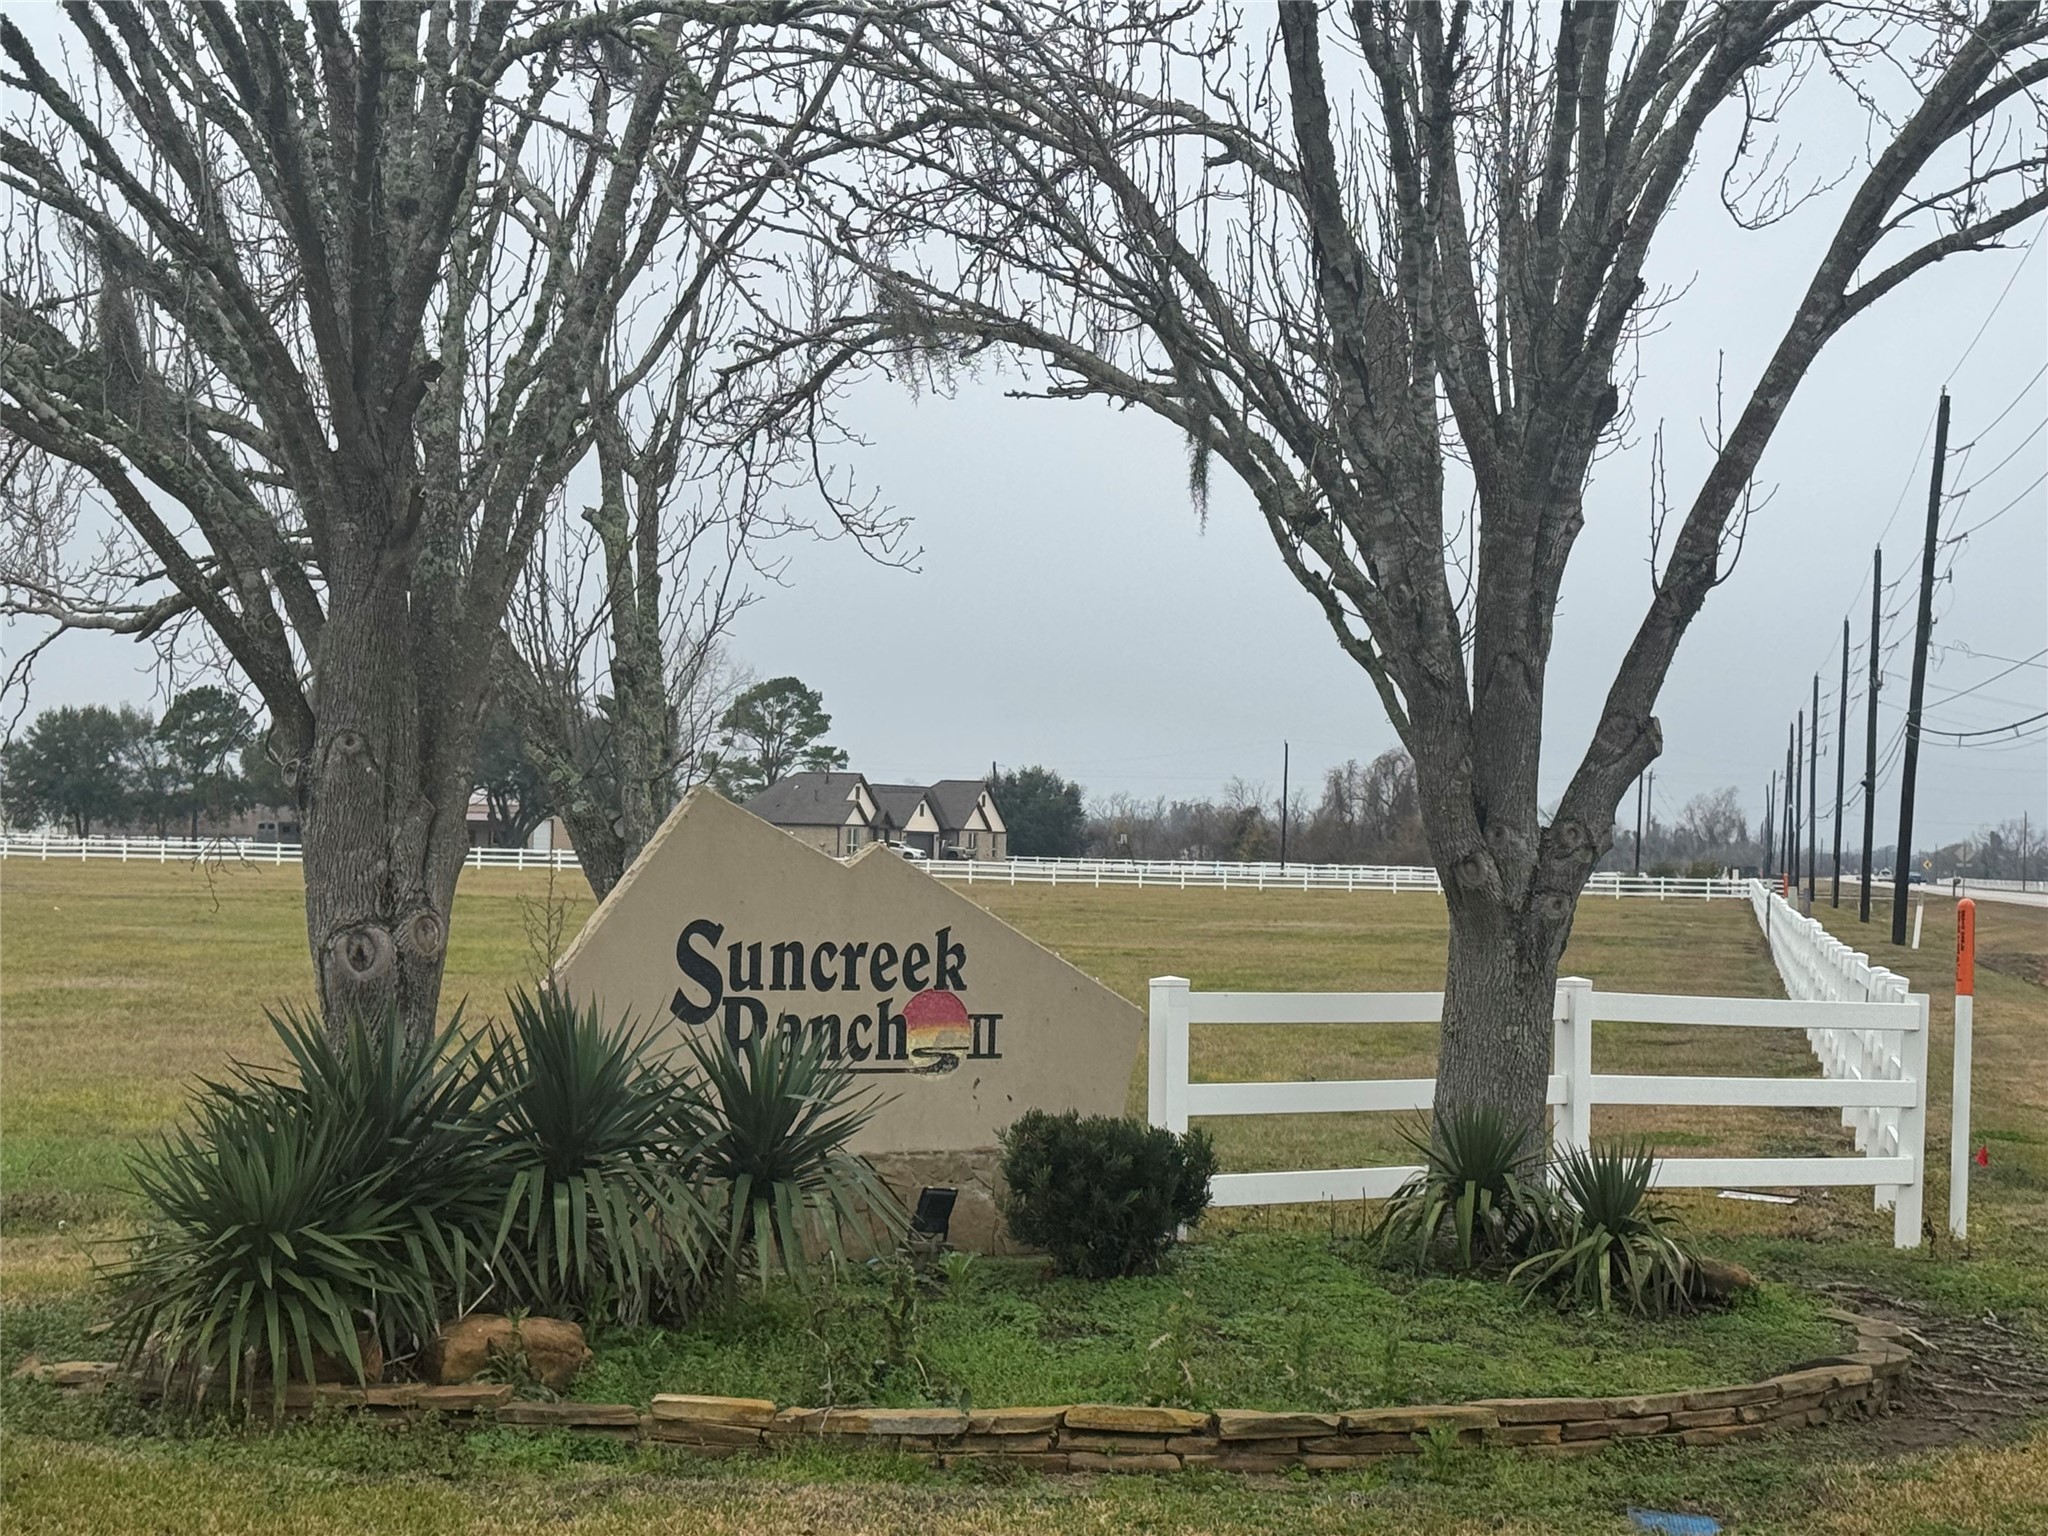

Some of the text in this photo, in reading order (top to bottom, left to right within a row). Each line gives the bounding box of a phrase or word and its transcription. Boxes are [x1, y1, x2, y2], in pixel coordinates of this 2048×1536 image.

[669, 919, 968, 1025] Suncreek
[721, 996, 1004, 1070] Ranch II
